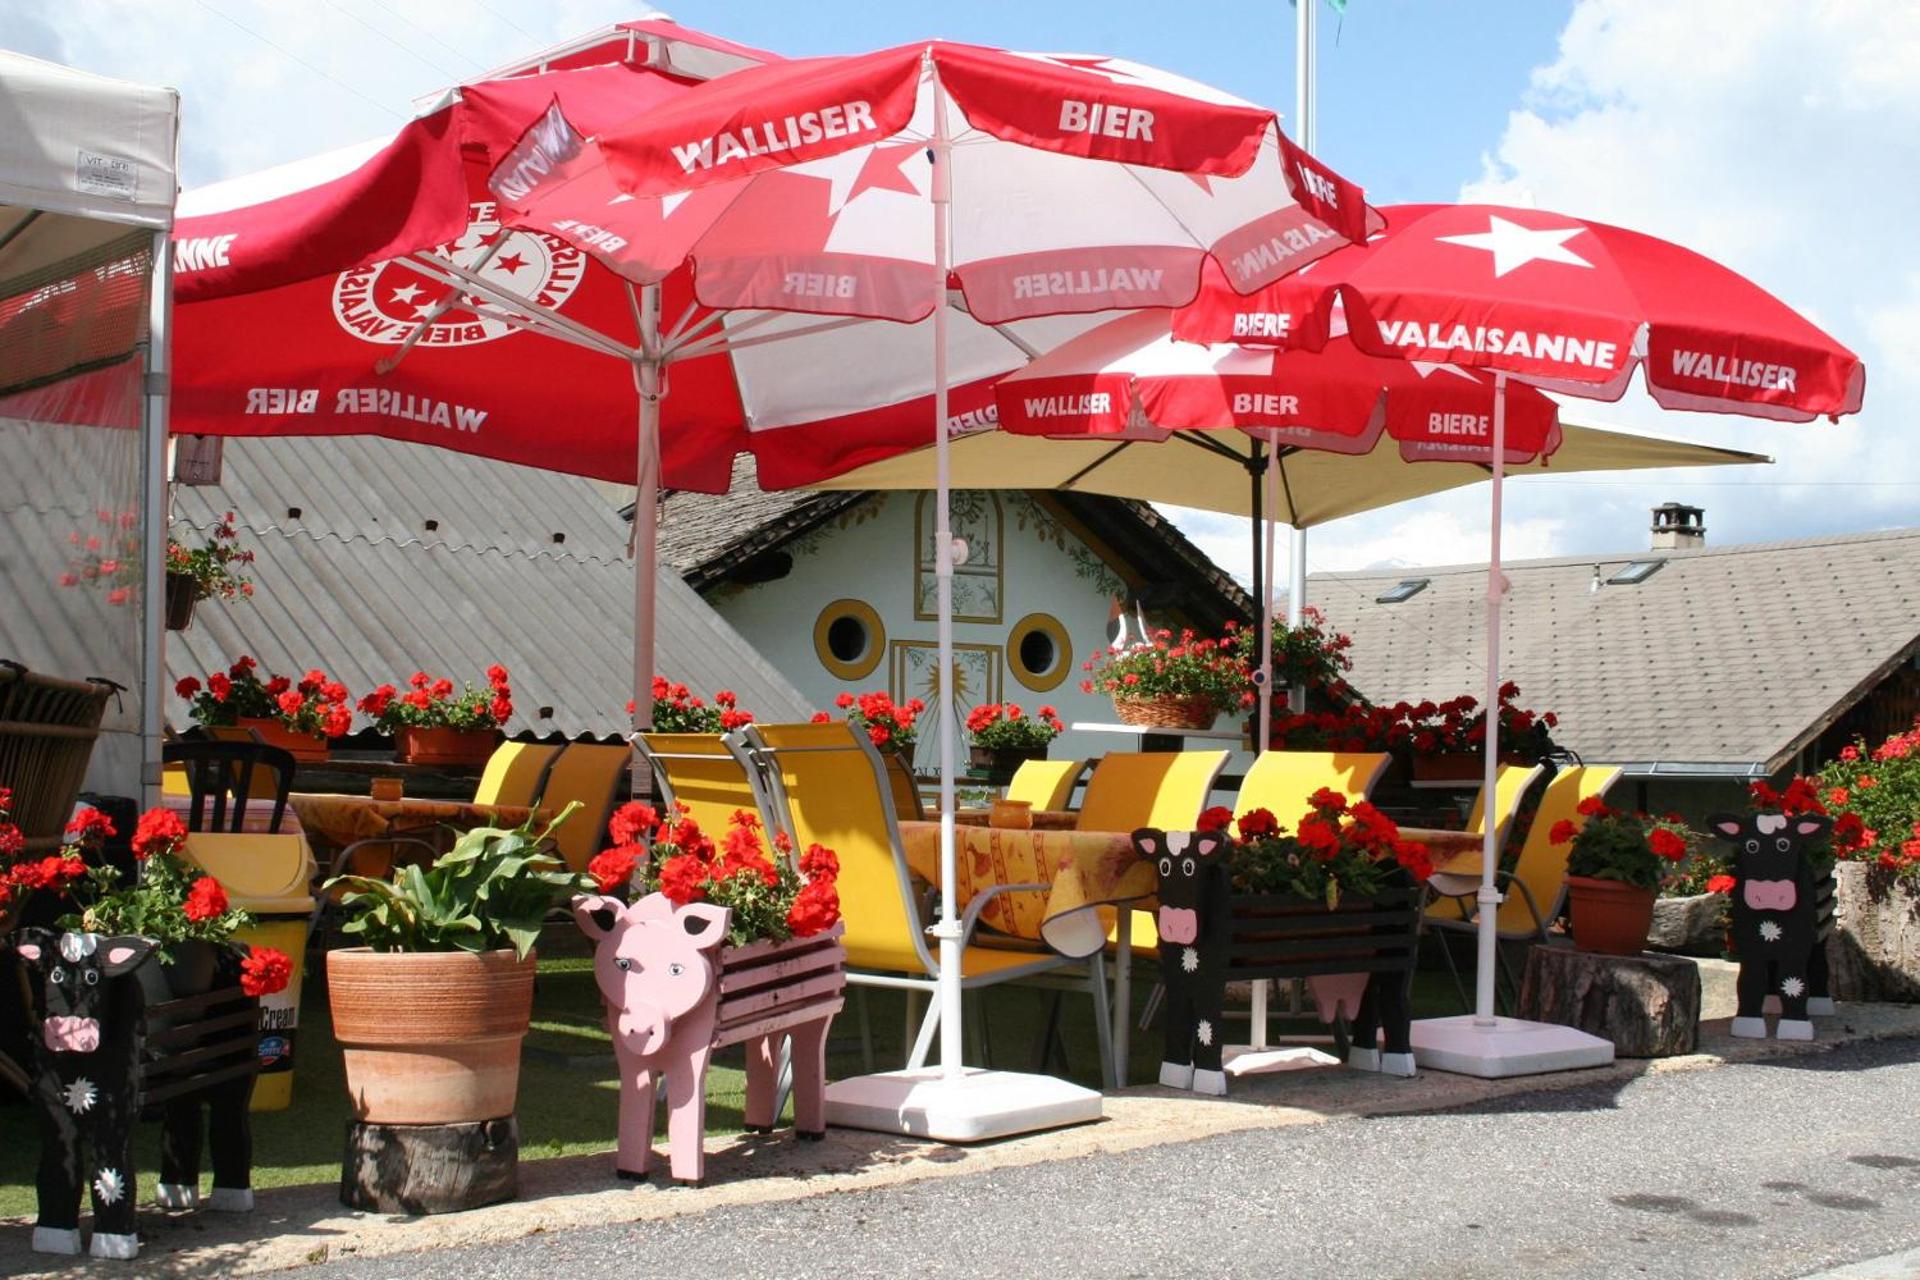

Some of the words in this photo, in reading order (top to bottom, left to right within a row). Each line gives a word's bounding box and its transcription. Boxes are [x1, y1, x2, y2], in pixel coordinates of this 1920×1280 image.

[671, 100, 878, 175] WALLISER
[1058, 99, 1155, 142] BIER
[1233, 312, 1291, 339] BIERE
[1377, 319, 1617, 370] VALAISANNE
[1672, 348, 1797, 393] WALLISER
[1024, 392, 1111, 418] WALLISER
[1233, 393, 1299, 415] BIER
[1428, 412, 1489, 437] BIERE
